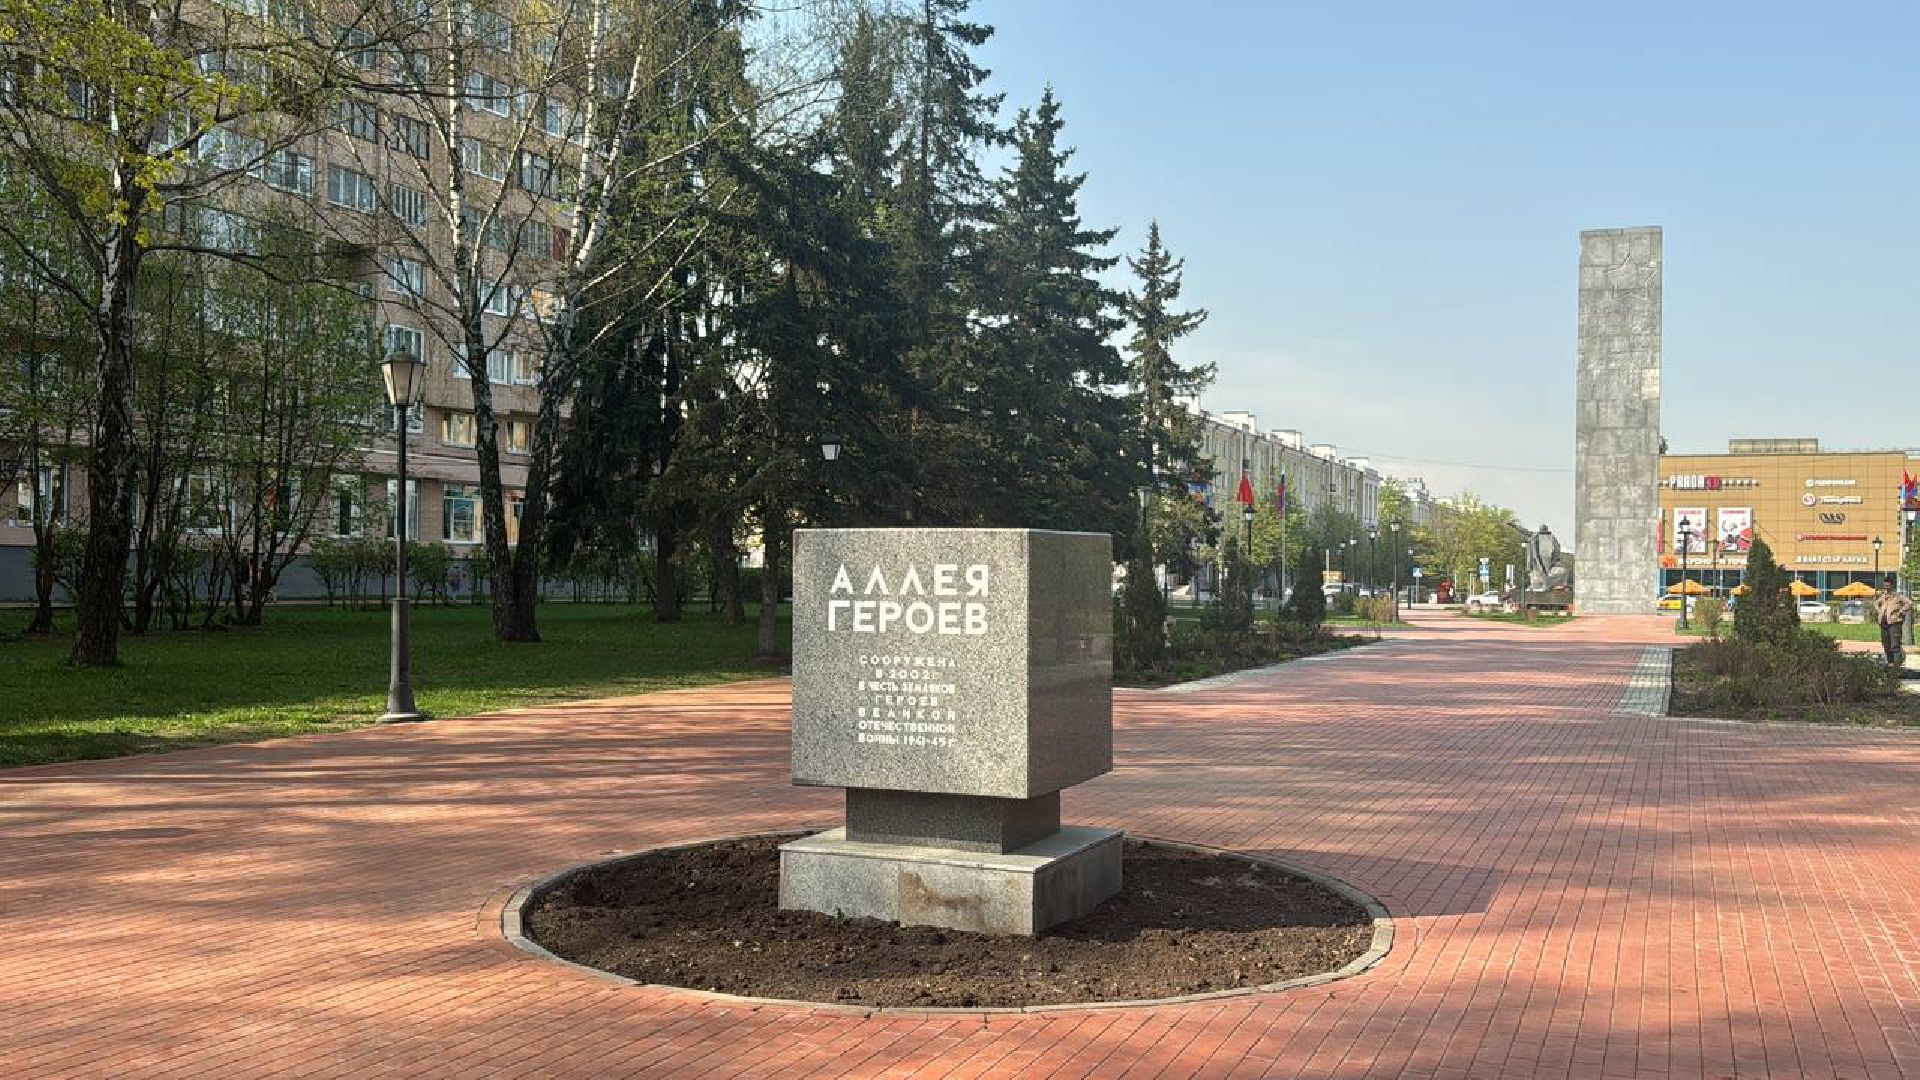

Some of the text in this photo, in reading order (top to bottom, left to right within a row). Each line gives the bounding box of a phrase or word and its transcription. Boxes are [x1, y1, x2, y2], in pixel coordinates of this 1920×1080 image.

[829, 563, 989, 598] АЛЛЕЯ
[828, 600, 989, 635] ГЕРОЕВ
[860, 654, 956, 668] СООРУЖЕНА
[875, 668, 883, 679] В
[867, 681, 899, 693] ЧЕСТЬ
[875, 695, 938, 707] ГЕРОЕВ
[858, 707, 956, 721] ВЕЛИКОЙ
[858, 720, 956, 734] ОТЕЧЕСТВЕННОЙ
[858, 732, 899, 745] ВОЙНЫ
